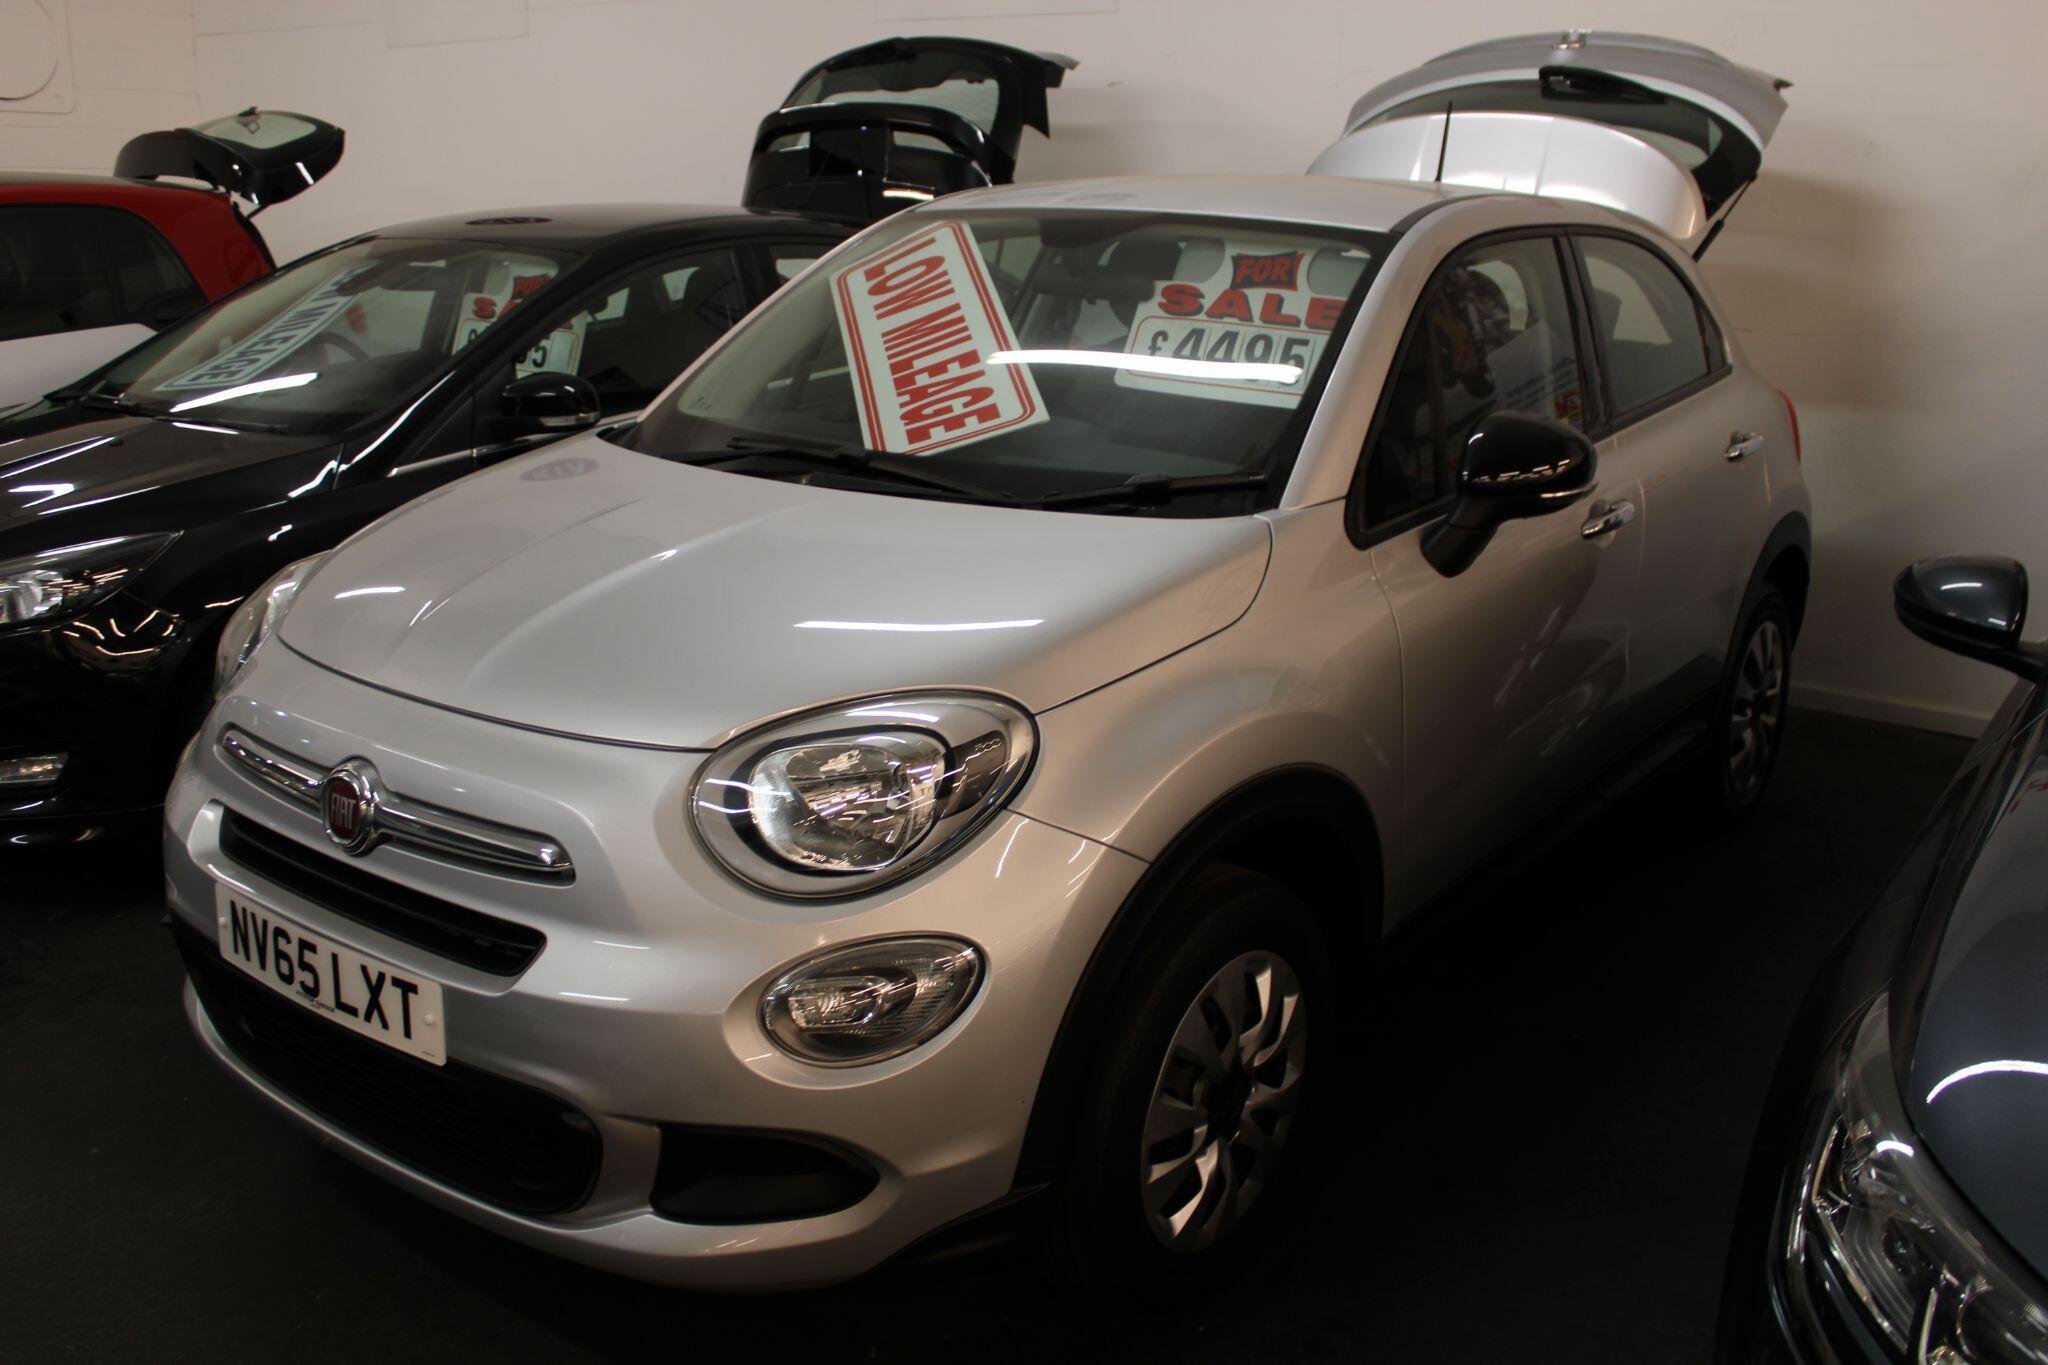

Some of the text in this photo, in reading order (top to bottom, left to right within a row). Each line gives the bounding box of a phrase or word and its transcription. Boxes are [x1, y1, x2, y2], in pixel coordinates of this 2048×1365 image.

[1235, 255, 1292, 284] FOR
[1157, 283, 1348, 331] SALE
[864, 237, 1001, 445] LOW MILEAGE
[330, 792, 356, 830] FIAT
[230, 900, 418, 1039] NV65 LXT
